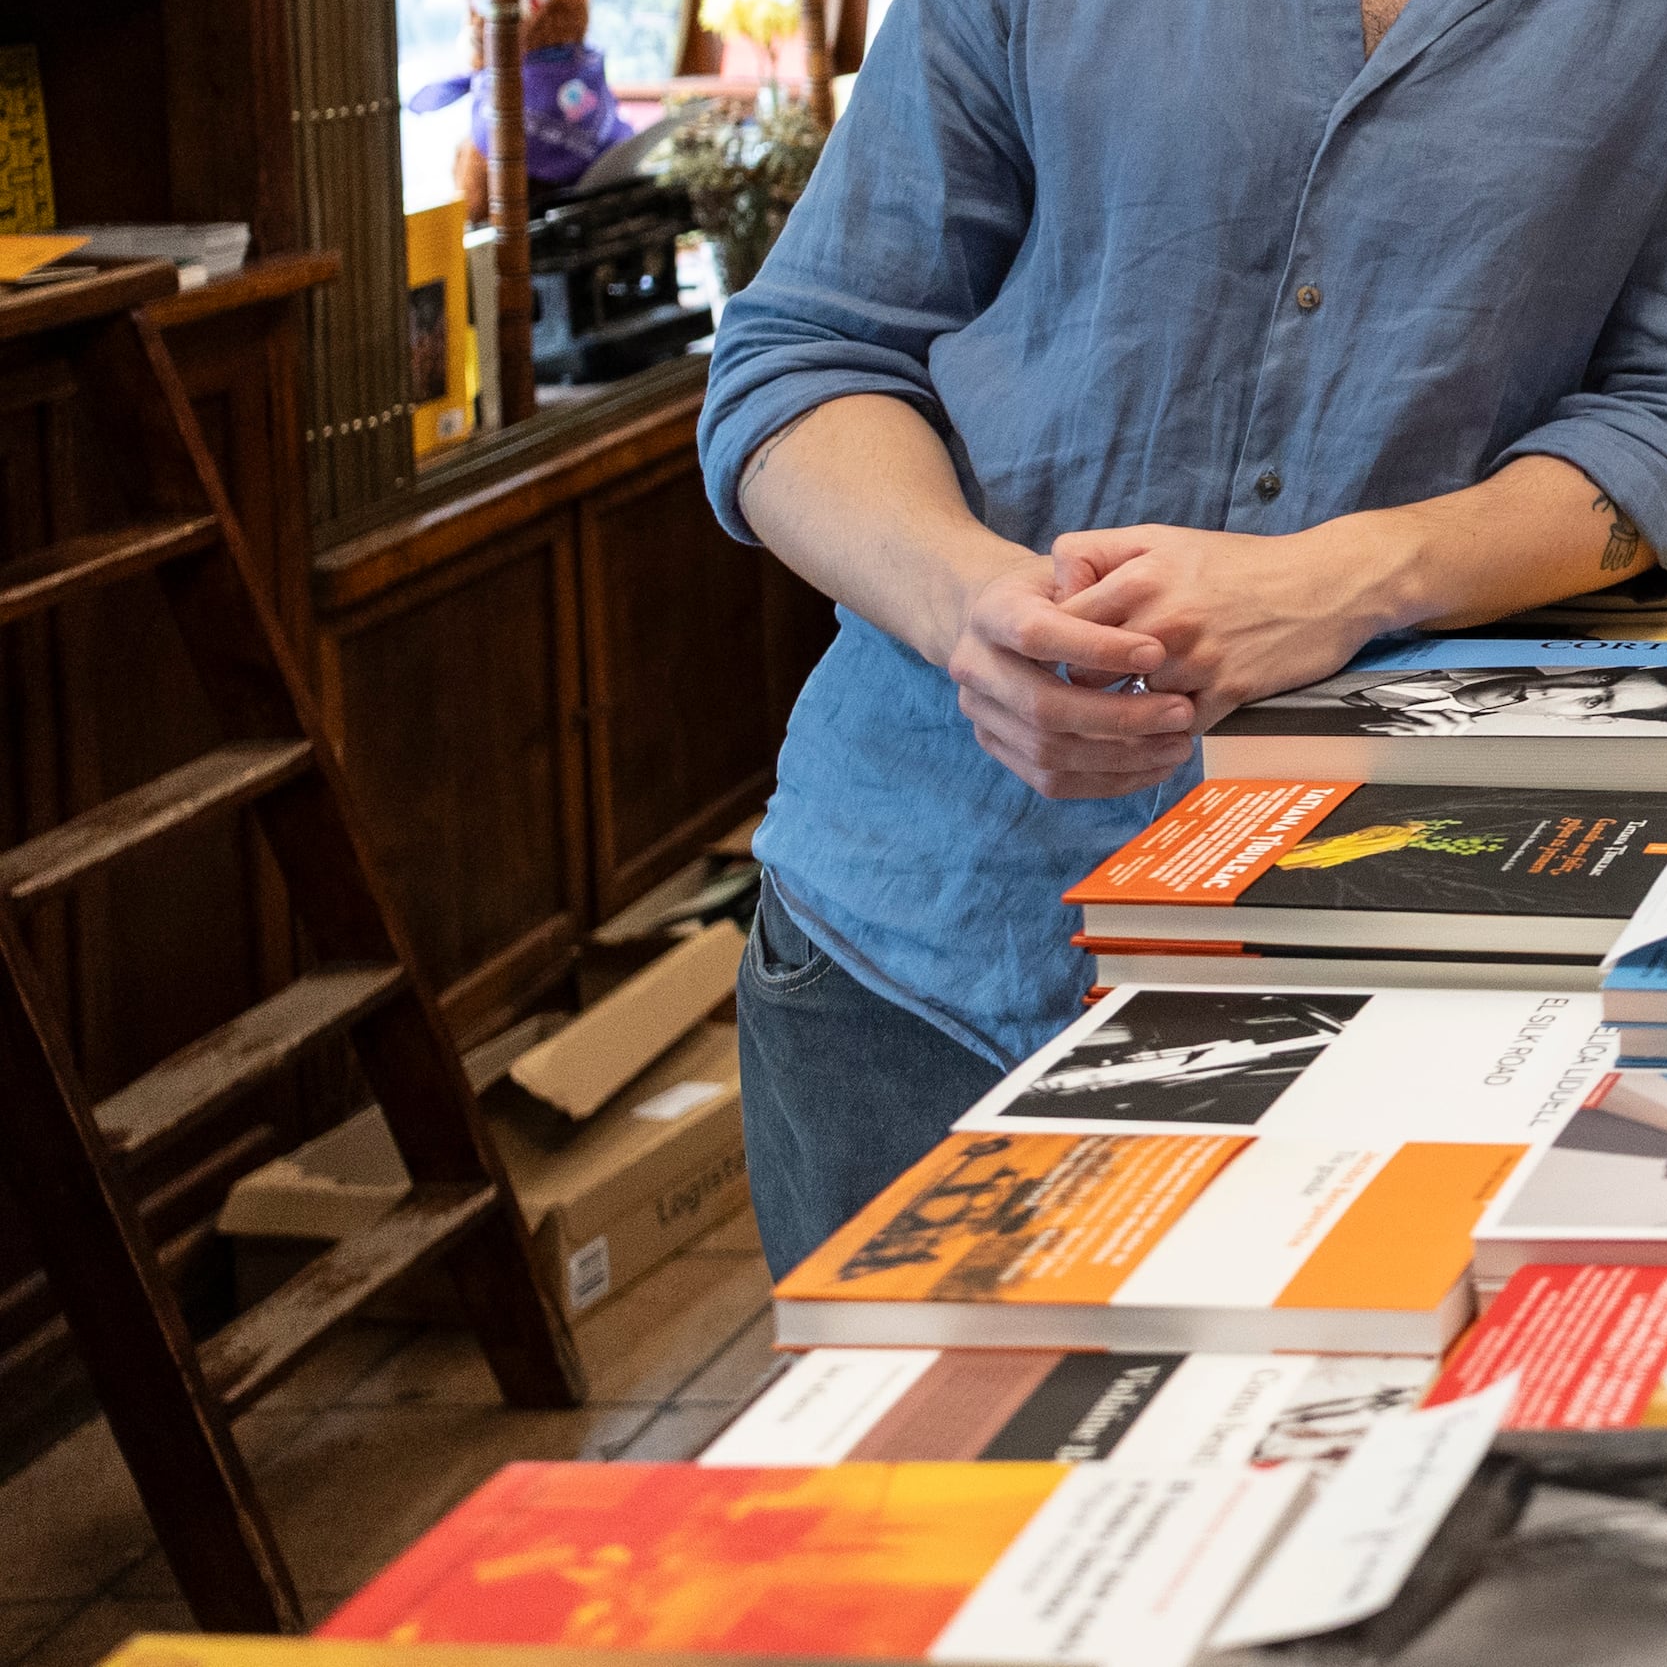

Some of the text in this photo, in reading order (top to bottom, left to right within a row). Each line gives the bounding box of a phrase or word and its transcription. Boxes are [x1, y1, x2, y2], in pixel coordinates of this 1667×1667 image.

[1265, 787, 1336, 833] TATIANA
[1613, 819, 1648, 845] TATIANA
[1483, 997, 1570, 1086] EL SILK ROAD
